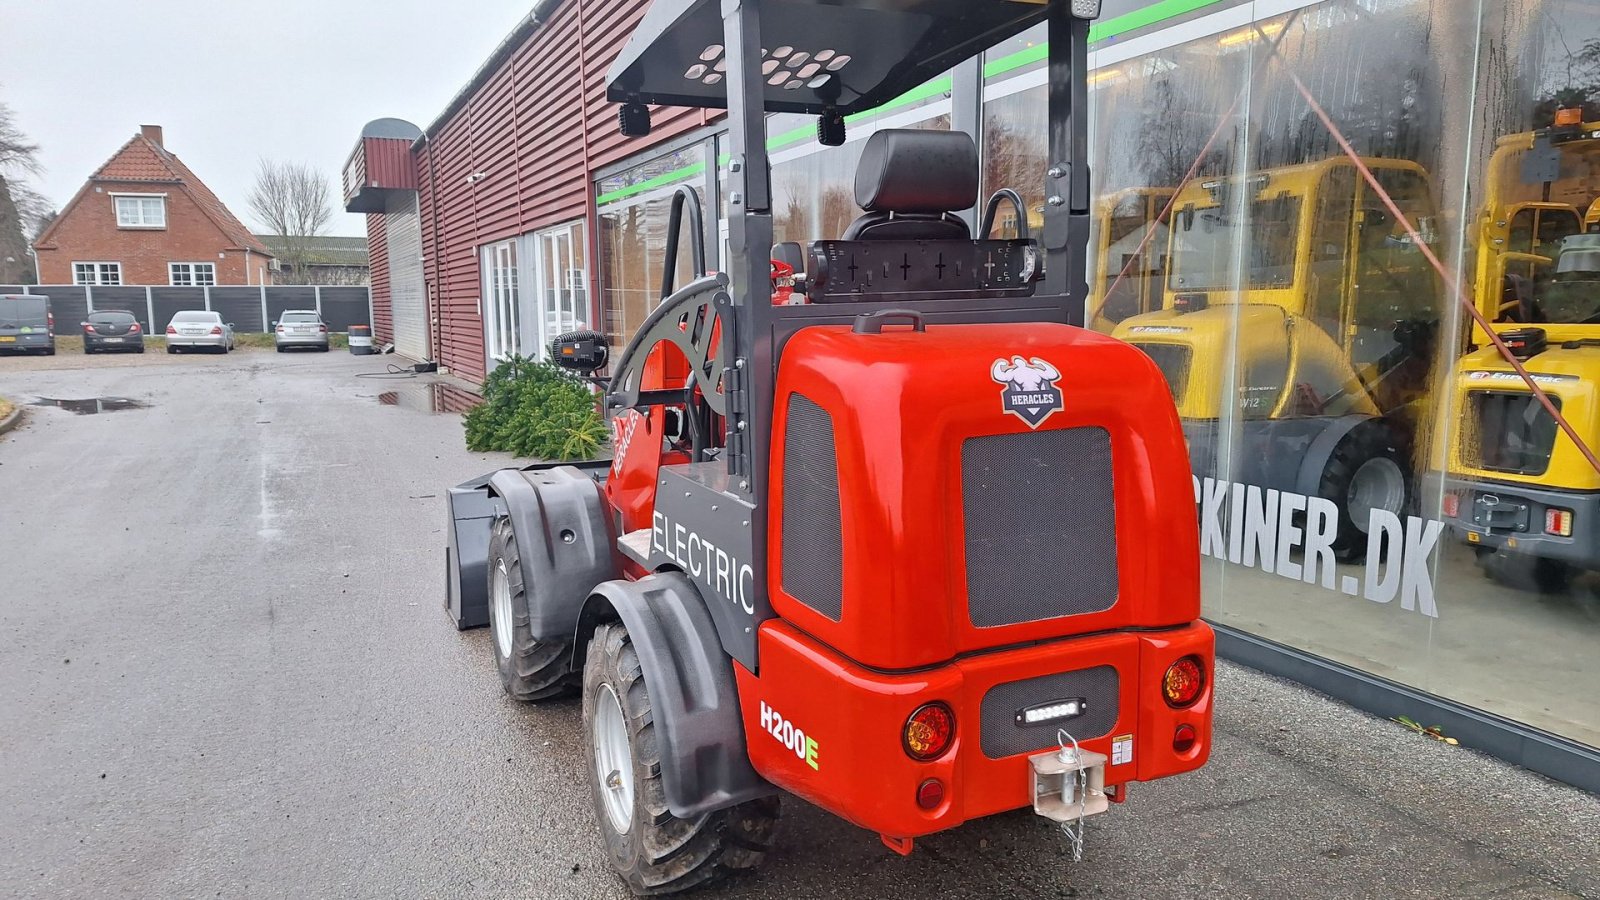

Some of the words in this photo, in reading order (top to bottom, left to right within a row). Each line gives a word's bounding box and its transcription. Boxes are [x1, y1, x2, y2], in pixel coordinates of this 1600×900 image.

[1011, 393, 1055, 405] HERACLES
[653, 510, 754, 615] ELECTRIC
[760, 700, 819, 771] H200E
